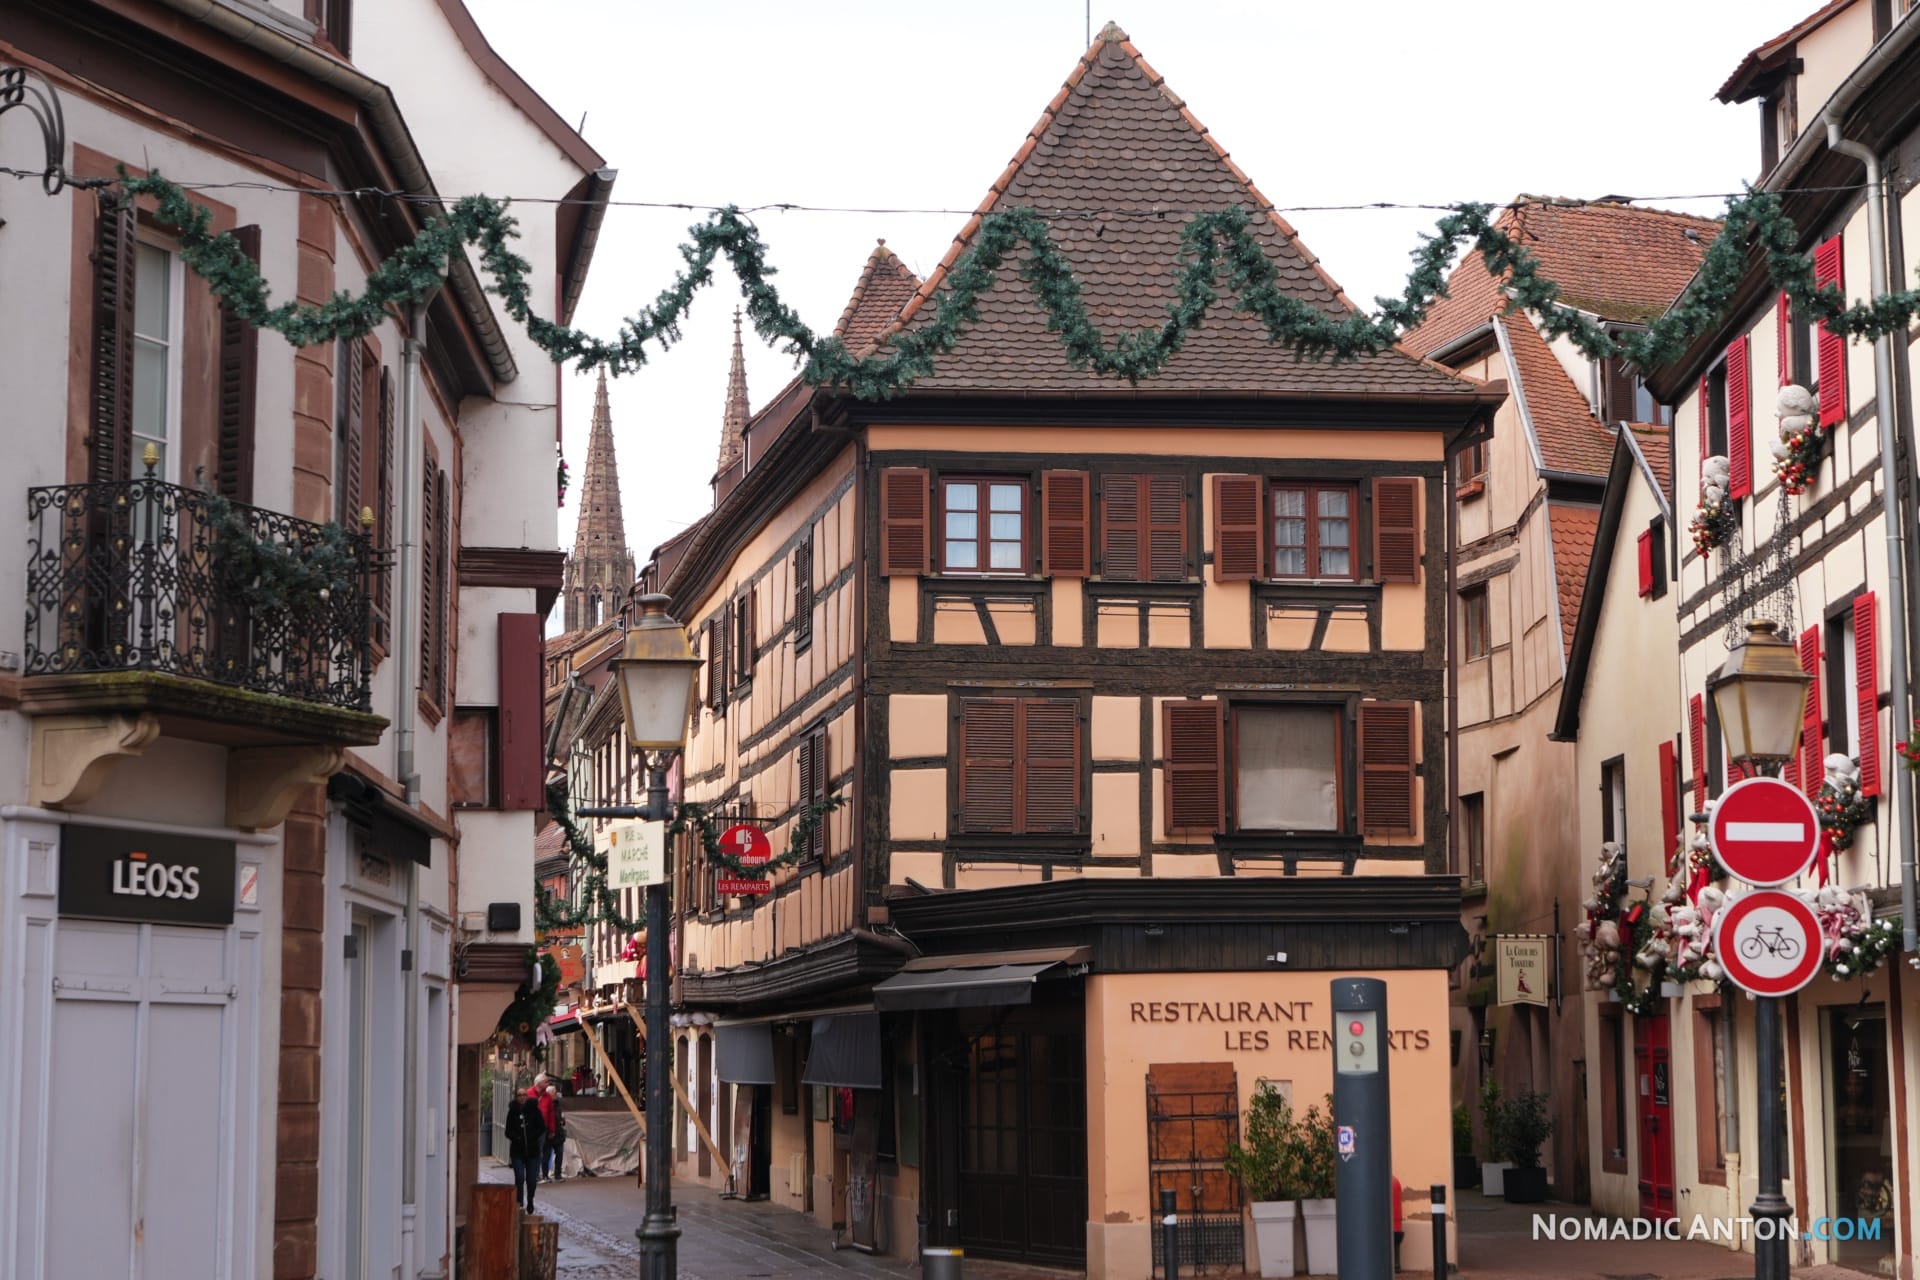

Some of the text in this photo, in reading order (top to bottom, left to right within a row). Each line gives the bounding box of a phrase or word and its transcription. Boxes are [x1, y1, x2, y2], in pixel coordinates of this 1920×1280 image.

[730, 882, 769, 891] REMPARTS
[1130, 1001, 1313, 1023] RESTAURANT
[1225, 1030, 1269, 1051] LES
